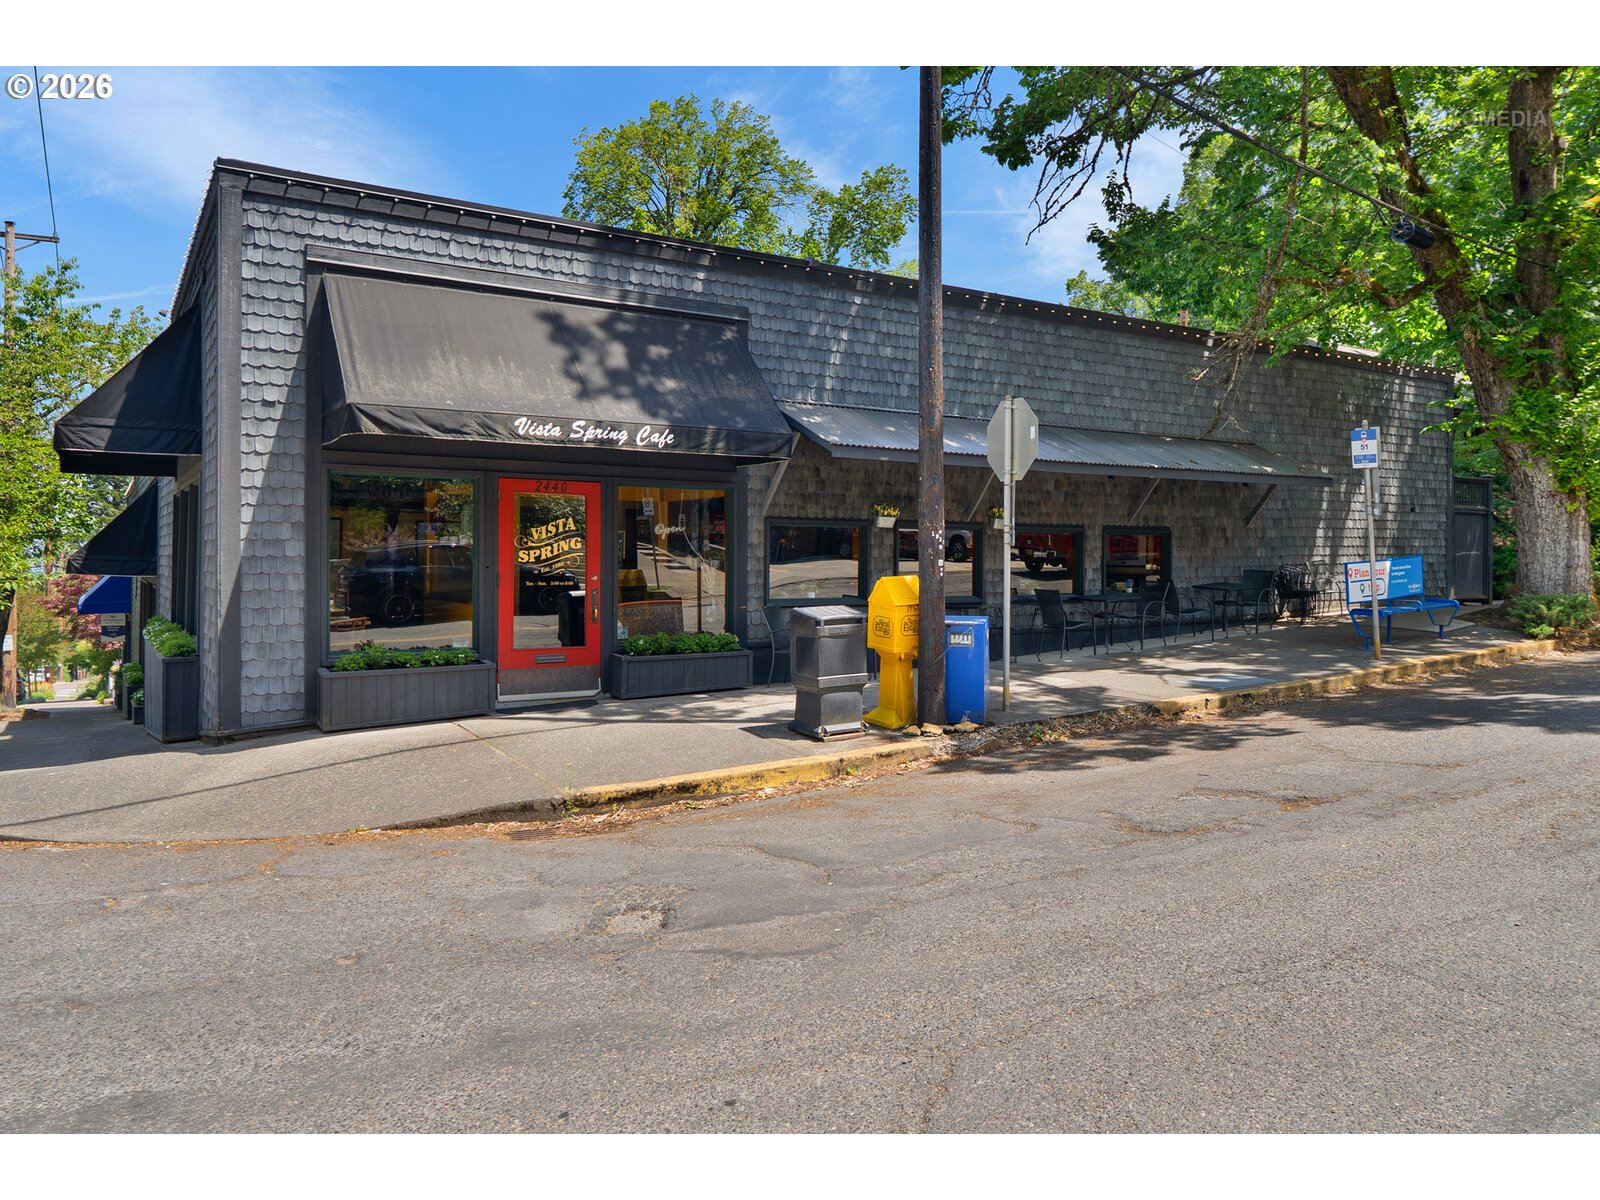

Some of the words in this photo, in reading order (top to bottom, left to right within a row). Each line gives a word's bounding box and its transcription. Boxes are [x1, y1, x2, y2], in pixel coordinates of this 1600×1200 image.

[514, 417, 562, 437] Vista
[570, 420, 629, 445] Spring
[636, 425, 675, 448] Cafe
[1360, 443, 1369, 451] 51
[535, 481, 568, 493] 2440
[531, 516, 577, 541] VISTA
[654, 523, 686, 540] Open
[518, 537, 582, 563] SPRING
[1353, 568, 1370, 579] Plan
[1374, 568, 1386, 576] our
[1367, 583, 1382, 594] tp.
